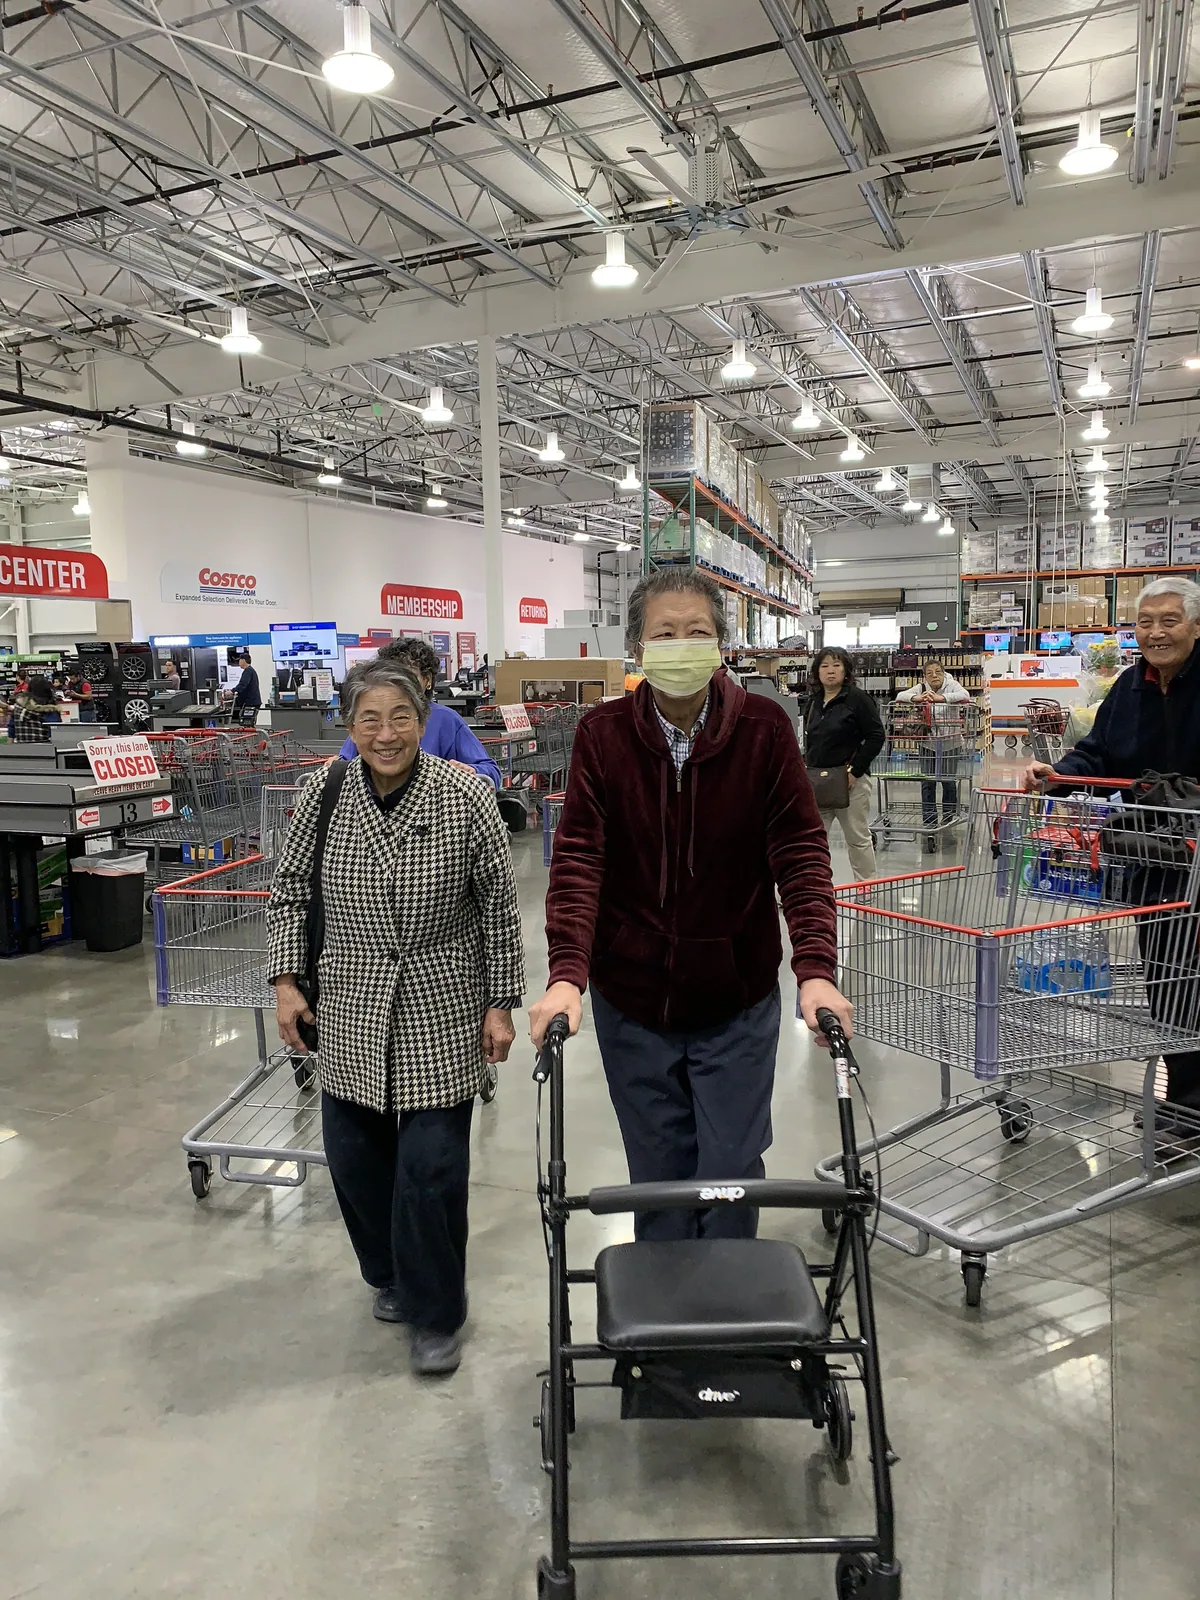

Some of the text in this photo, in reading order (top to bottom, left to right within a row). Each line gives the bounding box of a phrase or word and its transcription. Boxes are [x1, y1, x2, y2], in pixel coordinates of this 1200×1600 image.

[0, 555, 86, 590] CENTER
[175, 593, 201, 602] Expanded
[202, 595, 225, 603] Selection
[386, 595, 458, 618] MEMBERSHIP
[520, 604, 546, 619] RETURNS
[505, 716, 530, 729] CLOSED
[88, 741, 149, 756] Sorry, this lane
[516, 742, 524, 757] 15
[93, 755, 156, 781] CLOSED
[118, 802, 138, 825] 13
[153, 802, 163, 810] Cart
[698, 1387, 737, 1403] drive
